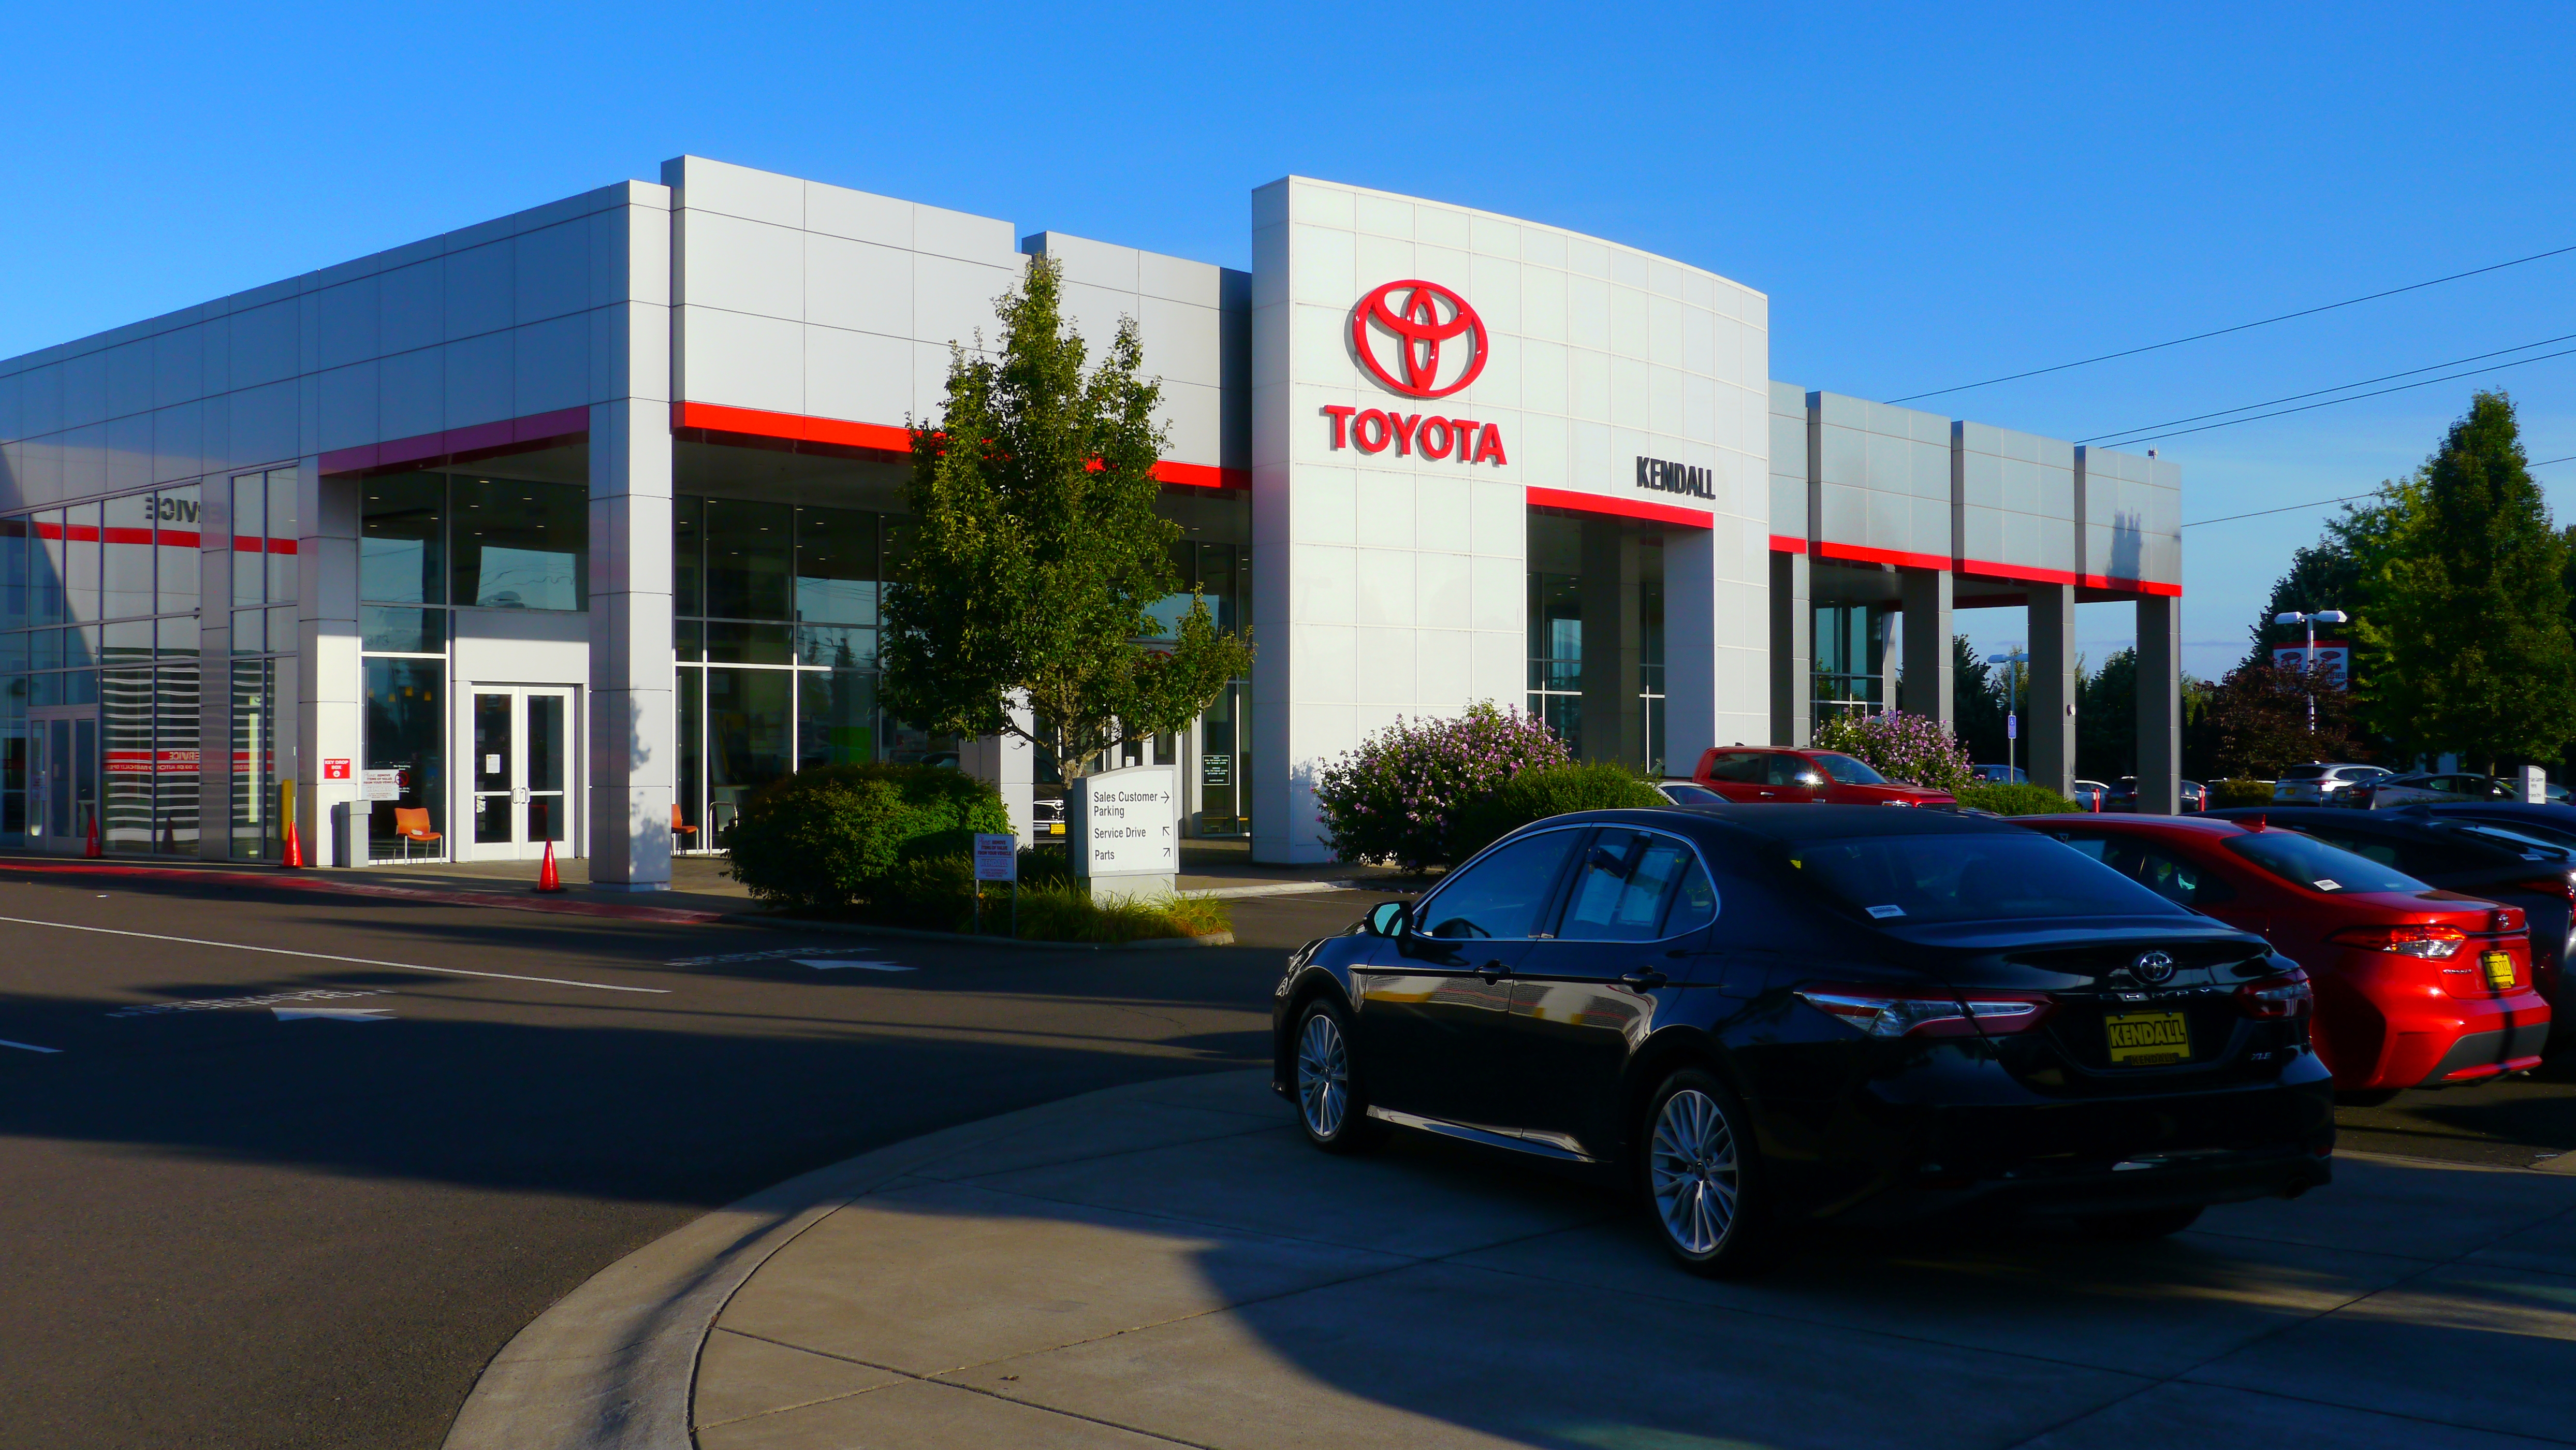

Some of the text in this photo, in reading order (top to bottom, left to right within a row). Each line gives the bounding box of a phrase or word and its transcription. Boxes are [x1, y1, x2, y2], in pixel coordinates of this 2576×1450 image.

[1324, 404, 1508, 466] TOYOTA
[1636, 456, 1716, 500] KENDALL
[1094, 791, 1158, 802] Sales Customer
[1094, 805, 1124, 818] Parking
[1094, 827, 1146, 838] Service Drive
[1095, 850, 1115, 860] Parts
[980, 859, 1008, 867] KENDALL
[2109, 1020, 2186, 1049] KENDALL
[2132, 1053, 2175, 1065] KENDALL
[2251, 1052, 2271, 1061] XLE
